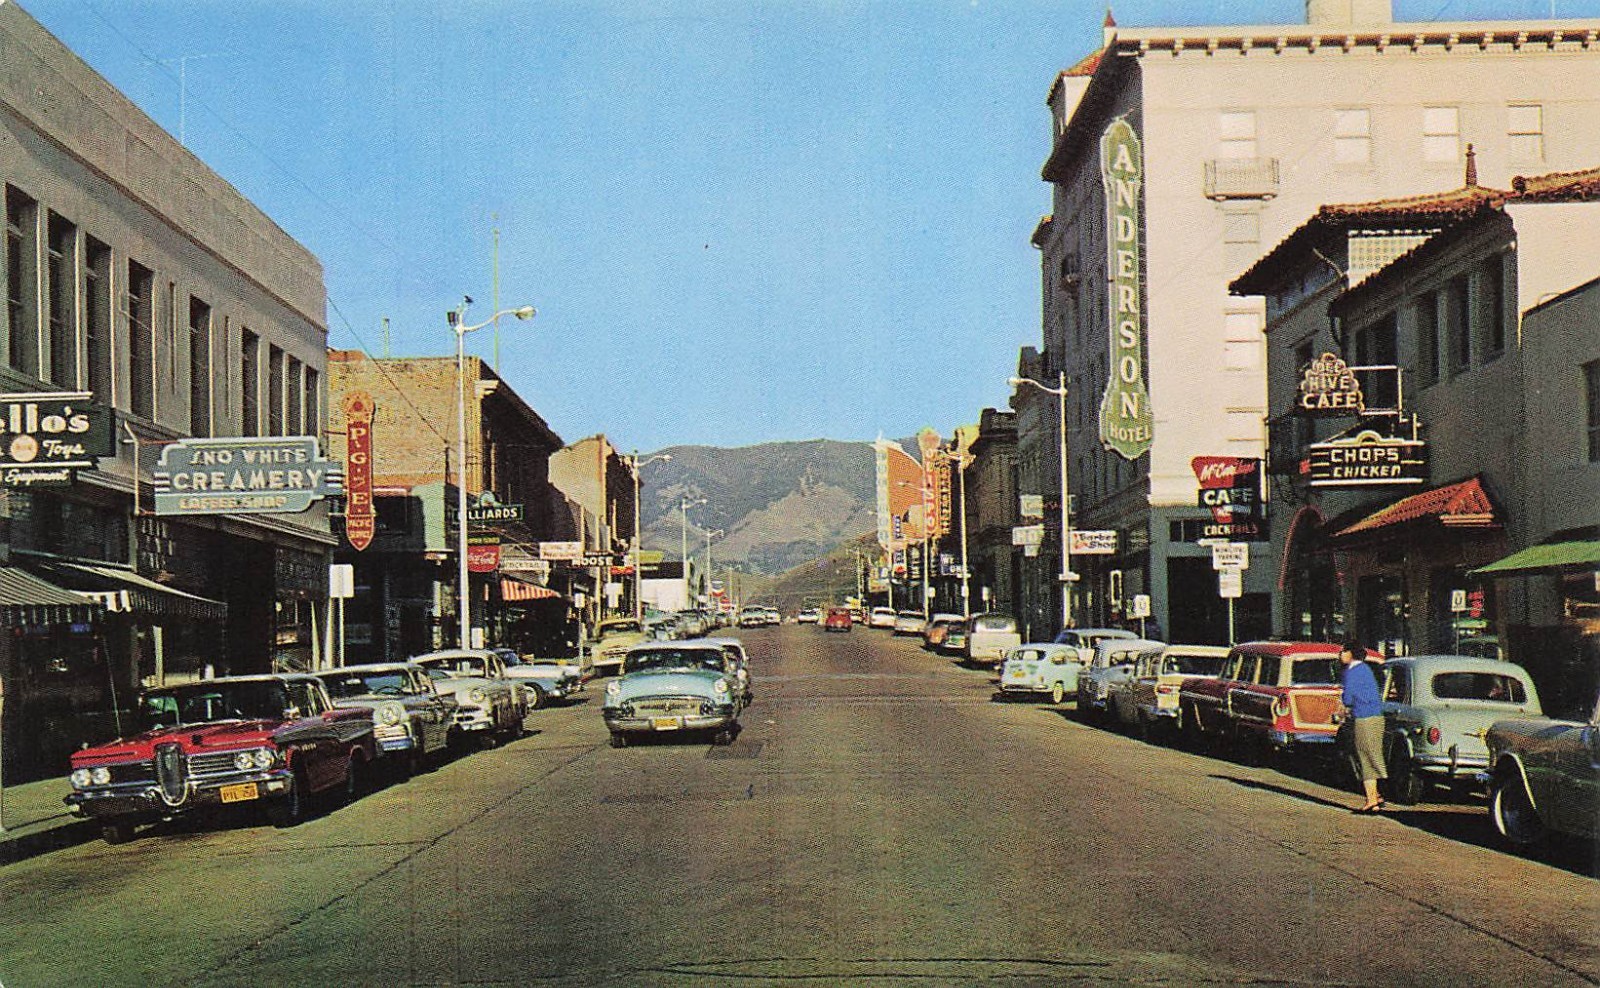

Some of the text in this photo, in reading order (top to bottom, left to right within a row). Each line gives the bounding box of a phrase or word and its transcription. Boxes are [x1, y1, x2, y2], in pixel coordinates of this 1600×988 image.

[1113, 144, 1140, 419] ANDERSON
[1308, 375, 1351, 390] HIVE
[1302, 391, 1358, 408] CAFE
[0, 404, 90, 433] llo's
[1110, 422, 1152, 444] HOTEL
[43, 440, 85, 459] Toys
[190, 449, 306, 465] SNO WHITE
[1330, 448, 1399, 462] CHOPS
[1333, 465, 1401, 478] CHICKEN
[173, 469, 323, 491] CREAMERY
[1203, 488, 1253, 506] CAFE
[458, 506, 518, 520] LLIARDS
[1079, 533, 1118, 541] Barber
[1088, 540, 1117, 549] Shop
[572, 556, 614, 566] MOOSE
